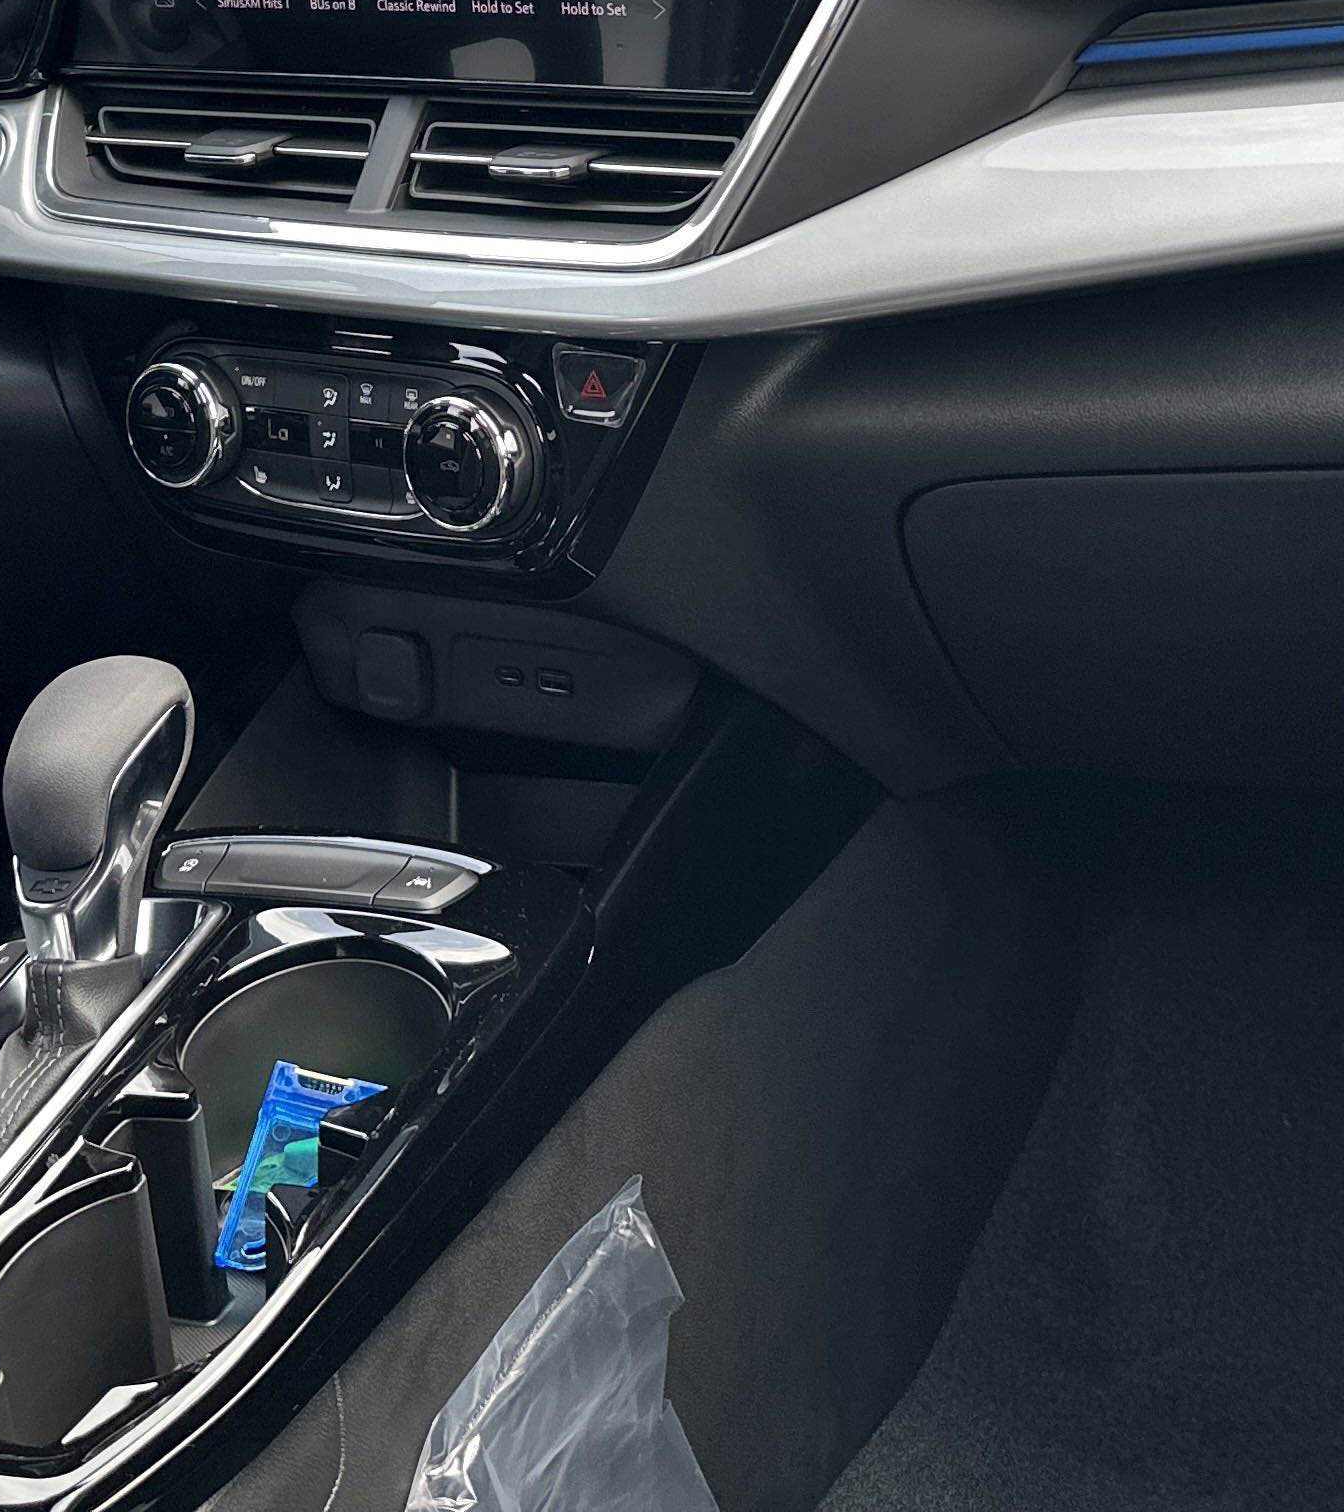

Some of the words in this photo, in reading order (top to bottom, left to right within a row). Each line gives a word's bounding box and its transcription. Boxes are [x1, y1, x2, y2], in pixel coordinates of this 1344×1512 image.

[332, 1, 347, 10] on
[416, 0, 456, 13] Rewind
[471, 0, 498, 13] Hold
[500, 2, 513, 14] to
[515, 1, 534, 14] Set
[561, 2, 590, 16] Hold
[591, 4, 604, 16] to
[606, 2, 627, 16] Set
[241, 376, 267, 387] ON/OFF
